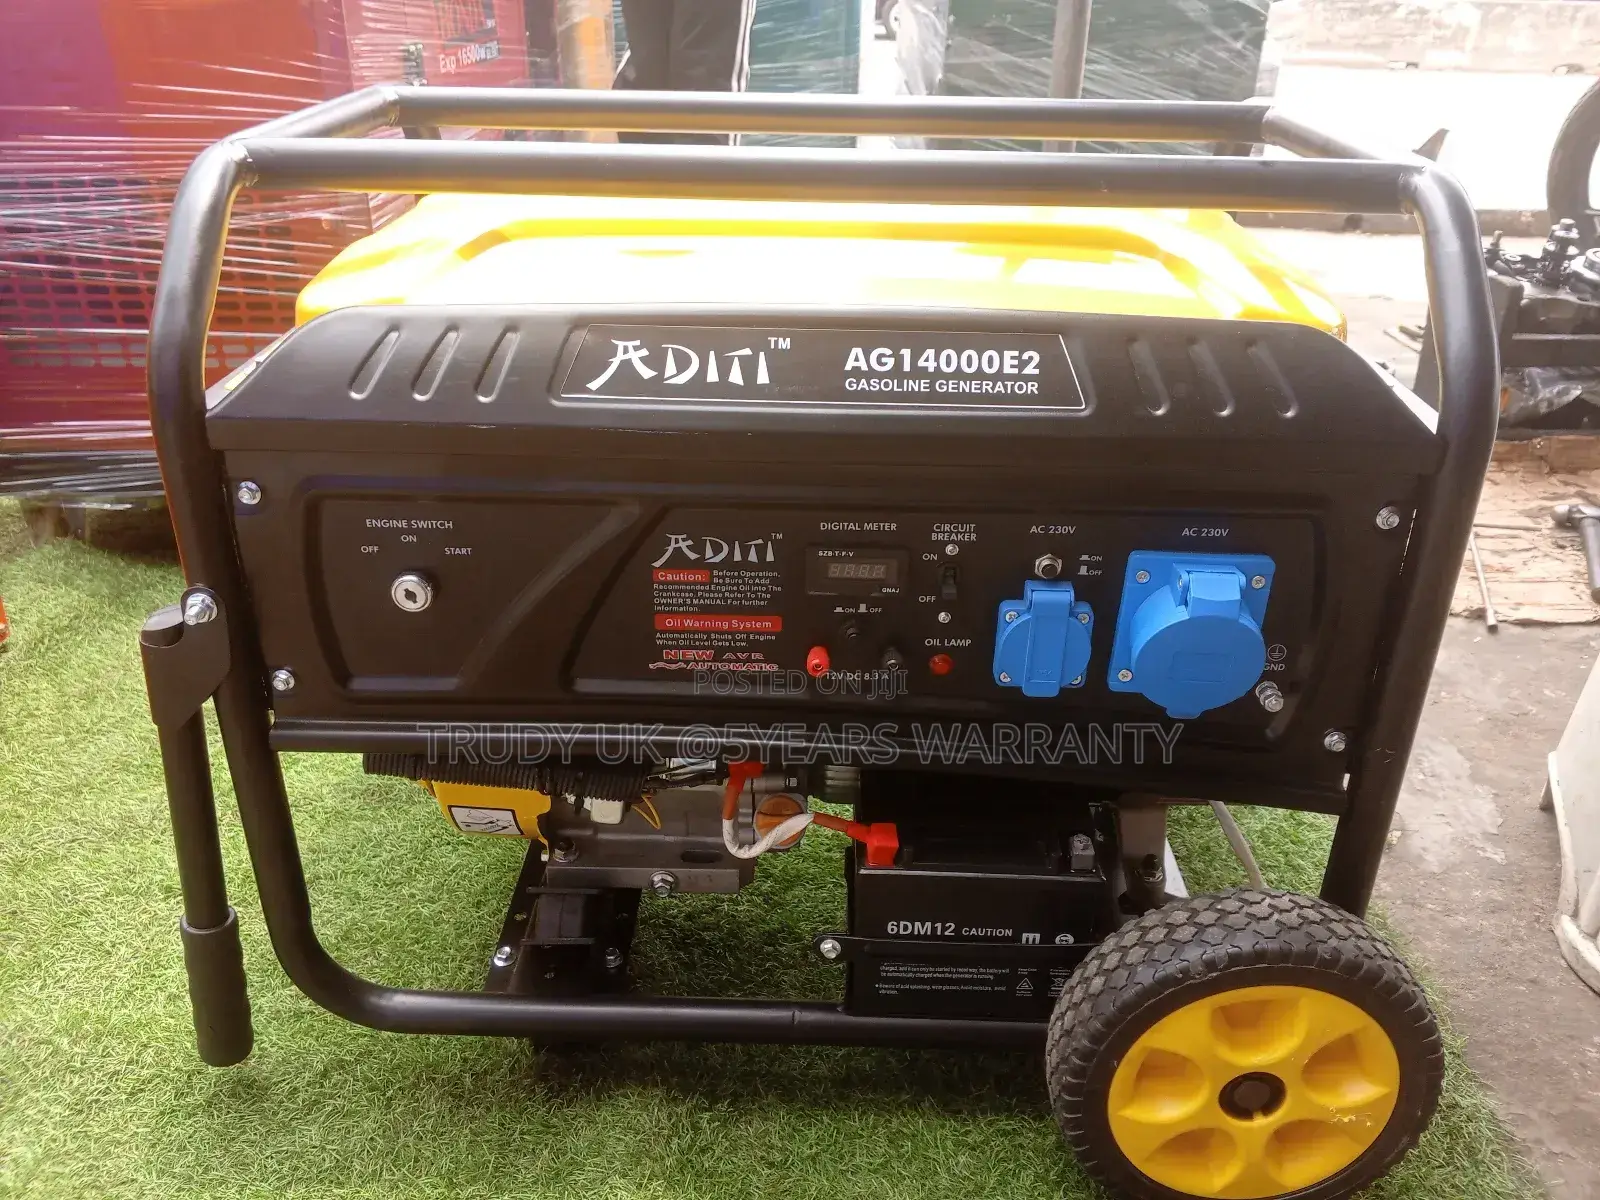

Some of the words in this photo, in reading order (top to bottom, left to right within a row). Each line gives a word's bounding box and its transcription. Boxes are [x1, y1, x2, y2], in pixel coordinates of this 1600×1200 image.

[440, 54, 457, 75] Exp
[585, 339, 770, 391] ADITI
[844, 347, 1040, 375] AG14000E2
[845, 378, 930, 392] GASOLINE
[935, 379, 1039, 394] GENERATOR
[366, 519, 408, 528] ENGINE
[411, 520, 453, 529] SWITCH
[820, 522, 860, 531] DIGITAL
[864, 523, 897, 531] METER
[933, 523, 976, 532] CIRCUIT
[1029, 525, 1045, 534] AC
[1048, 526, 1076, 534] 230V
[1181, 528, 1198, 537] AC
[1201, 528, 1229, 537] 230V
[931, 533, 977, 541] BREAKER
[360, 545, 379, 553] OFF
[444, 547, 472, 555] START
[651, 533, 775, 568] ADITI
[922, 553, 938, 561] ON
[658, 572, 706, 581] Caution:
[711, 585, 738, 593] Engine
[918, 595, 937, 603] OFF
[665, 619, 681, 627] Oil
[684, 619, 729, 629] Warning
[732, 620, 772, 631] System
[656, 632, 708, 640] Automatically
[944, 639, 972, 647] LAMP
[663, 650, 714, 660] NEW
[686, 662, 779, 671] AUTOMATIC
[1263, 663, 1285, 671] GND
[826, 672, 843, 680] 12V
[887, 921, 955, 936] 6DM12
[962, 927, 1013, 937] CAUTION
